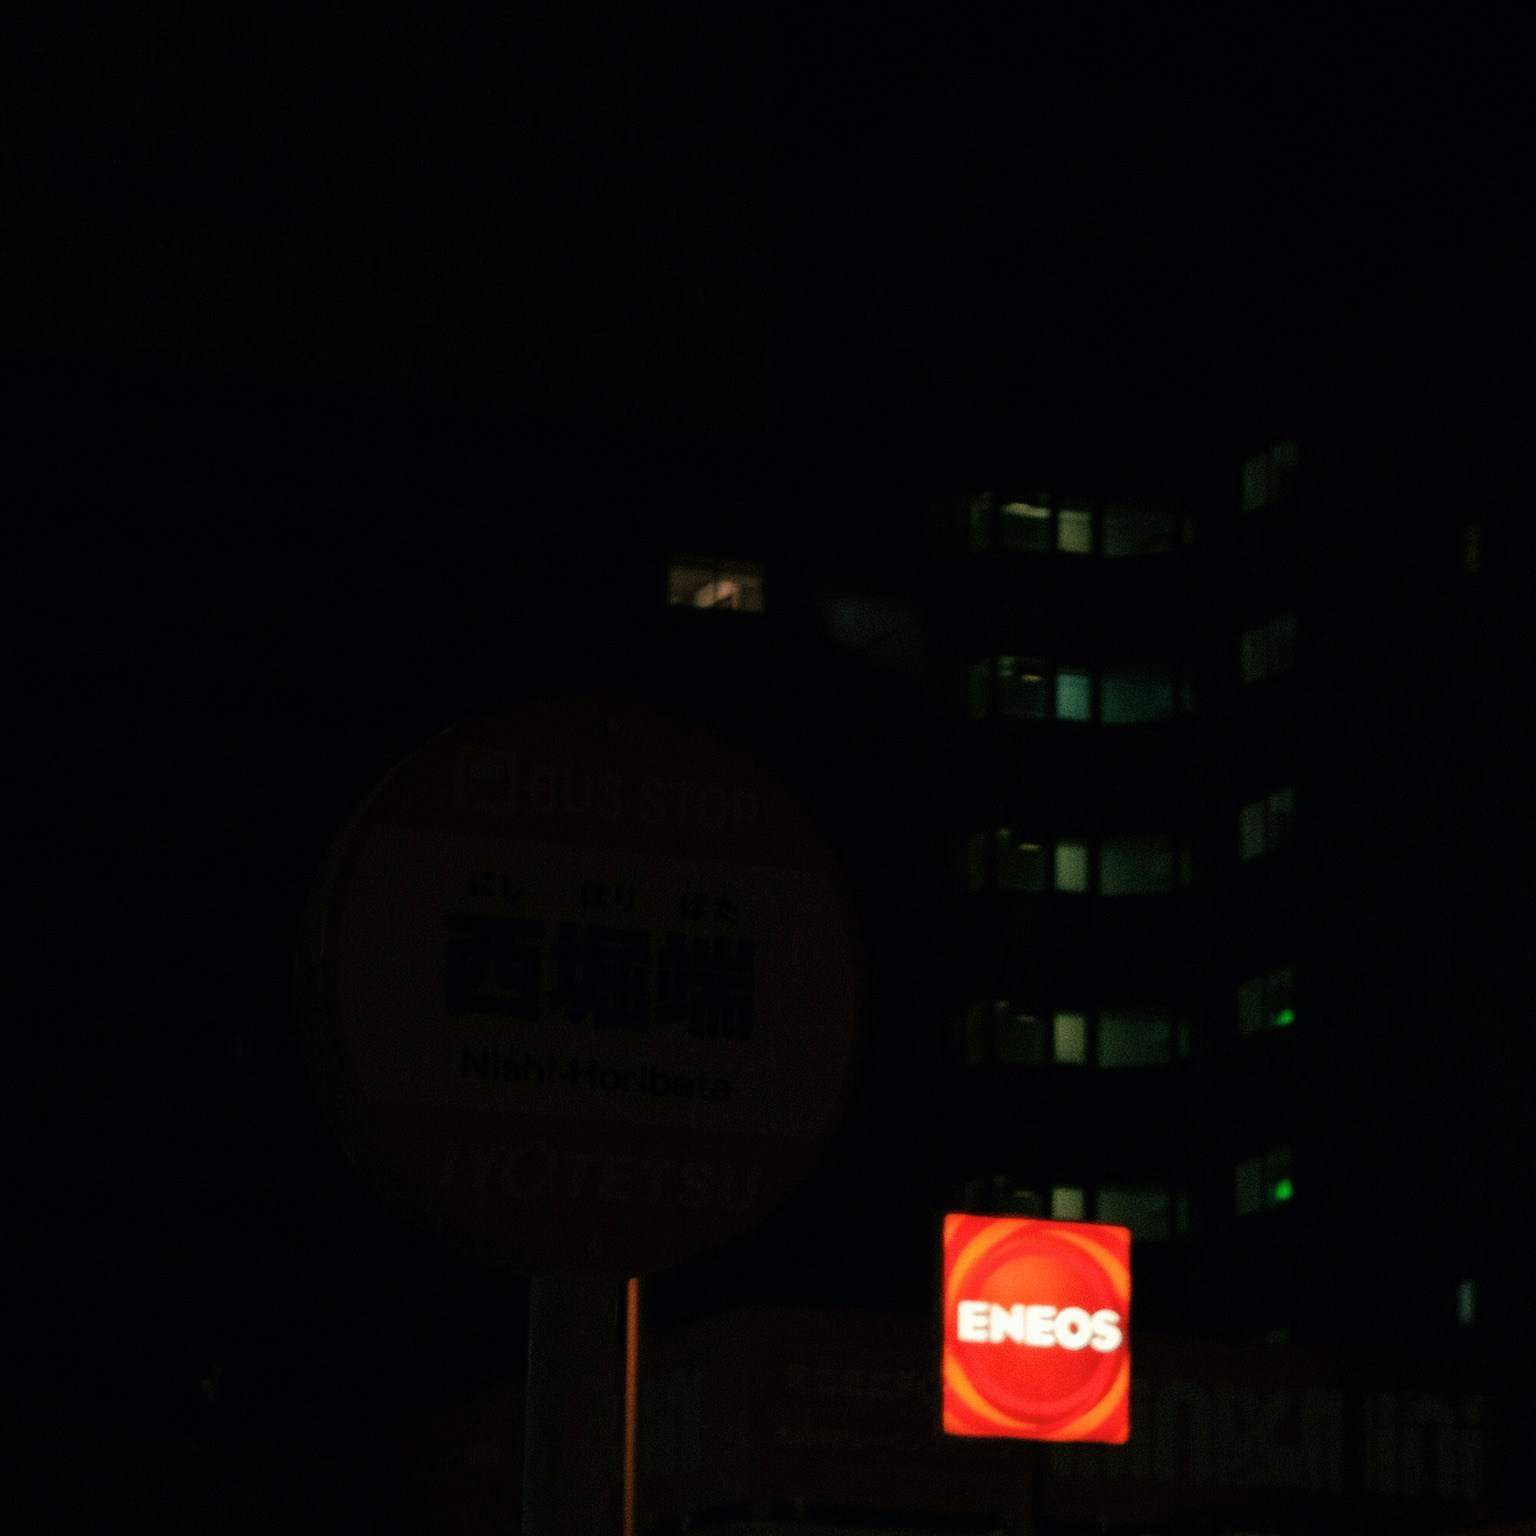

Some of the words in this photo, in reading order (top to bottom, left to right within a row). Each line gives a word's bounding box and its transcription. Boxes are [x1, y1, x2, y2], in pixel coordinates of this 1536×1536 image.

[529, 763, 626, 823] BUS
[639, 773, 761, 836] STOP
[445, 911, 757, 1042] 西堀端
[460, 1047, 732, 1102] Nishi-Horibata
[438, 1138, 763, 1213] IYOTETSU
[957, 1300, 1122, 1353] ENEOS
